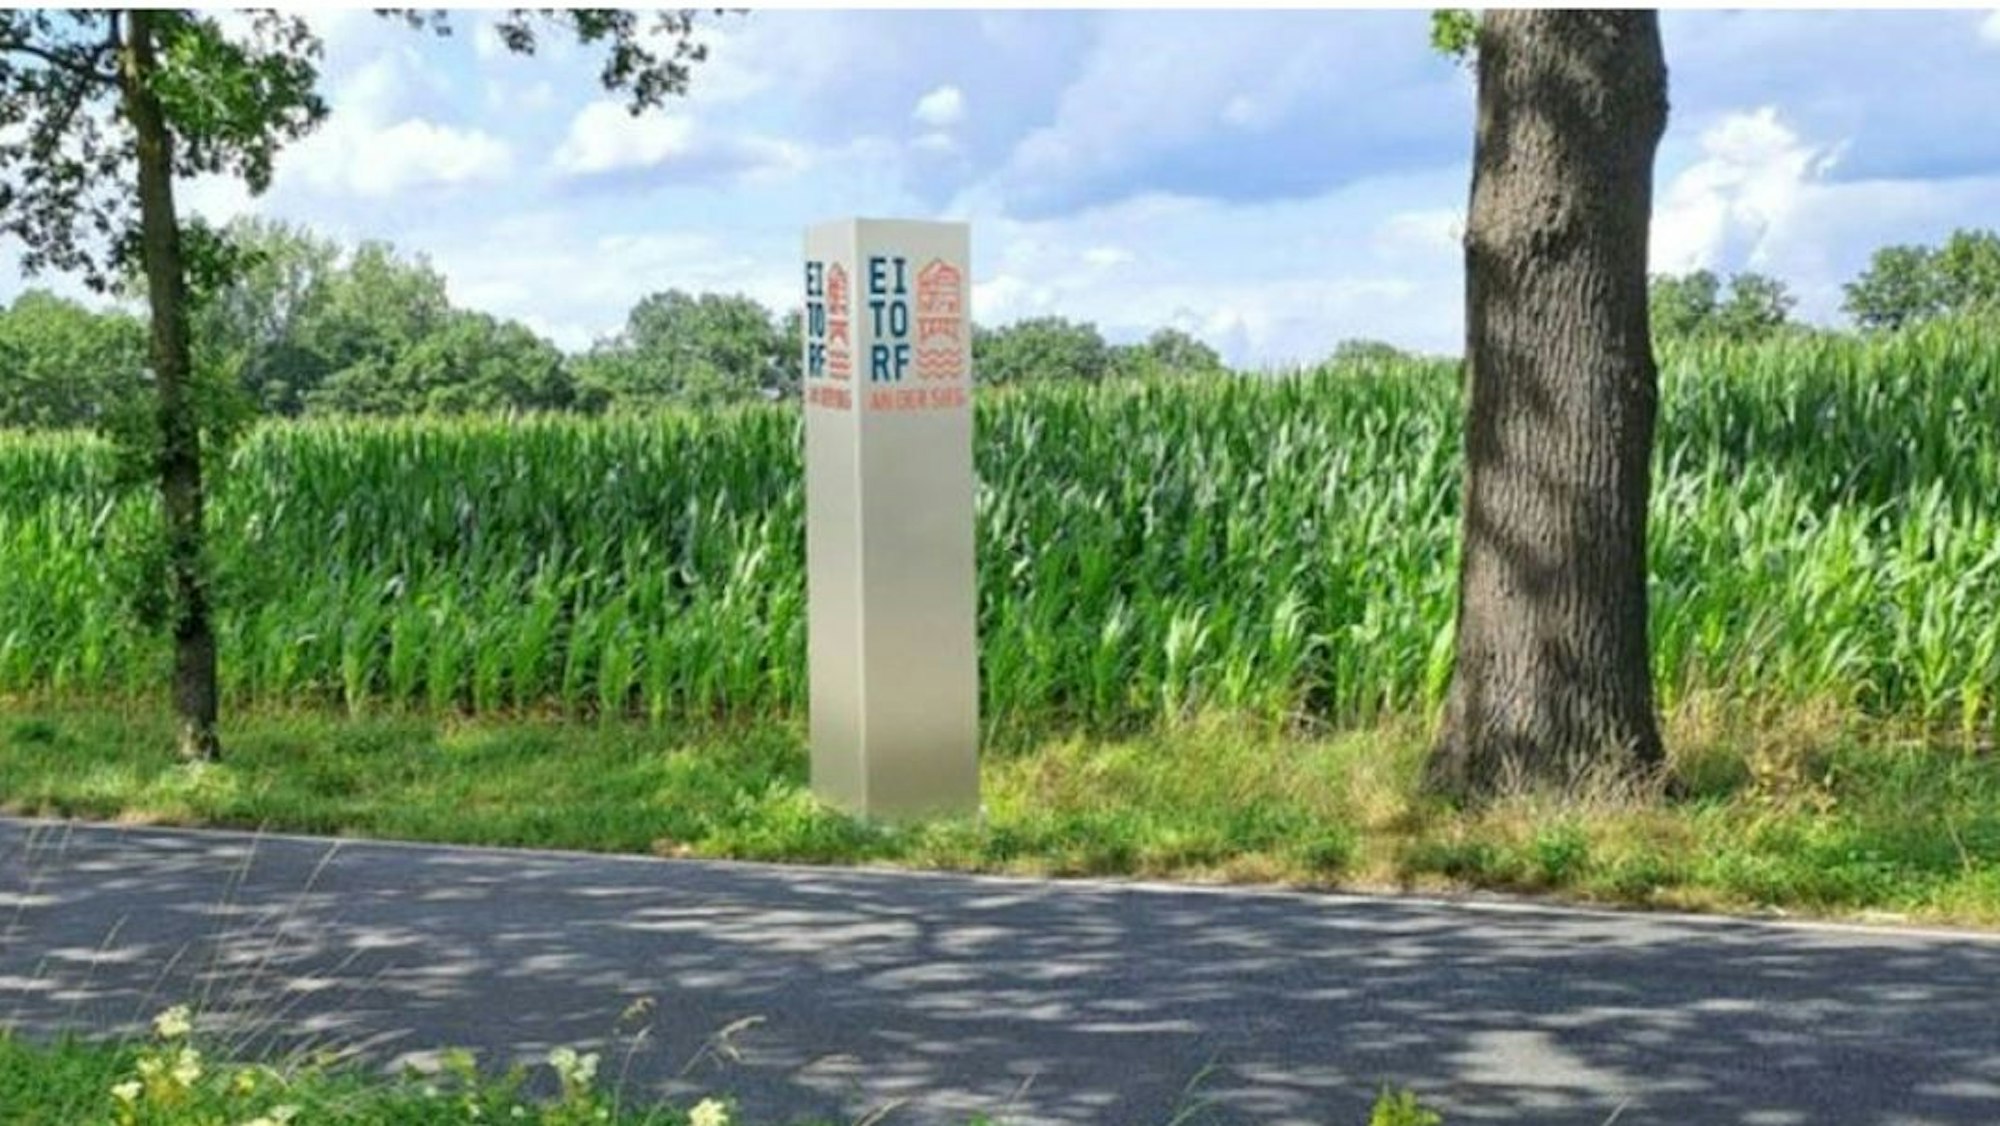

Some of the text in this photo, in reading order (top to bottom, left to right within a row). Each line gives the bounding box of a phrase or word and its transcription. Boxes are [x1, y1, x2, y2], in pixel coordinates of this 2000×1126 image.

[869, 257, 906, 294] EI
[869, 301, 907, 338] TO
[871, 344, 910, 382] RF
